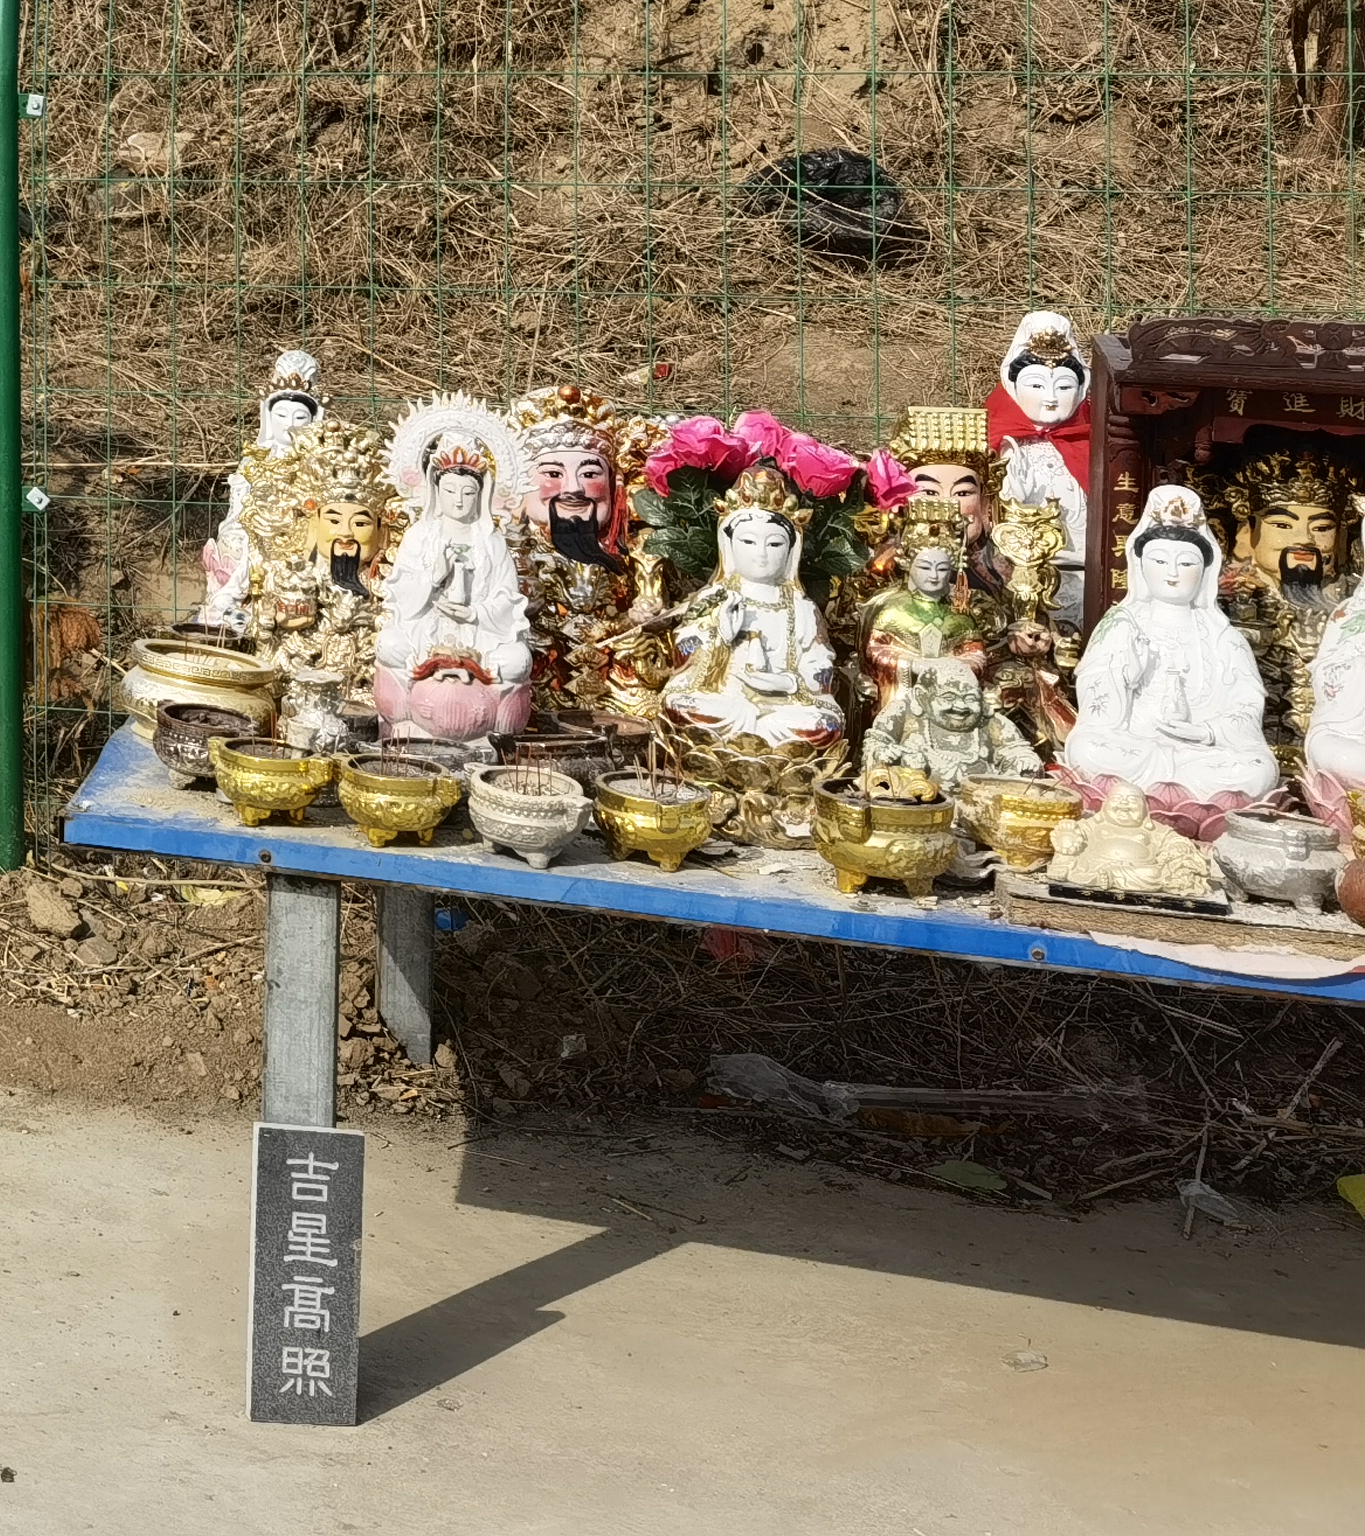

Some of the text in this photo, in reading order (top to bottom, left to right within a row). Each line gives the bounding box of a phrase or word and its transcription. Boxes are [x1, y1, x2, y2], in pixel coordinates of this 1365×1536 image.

[1110, 471, 1140, 607] 生意興隆
[278, 1151, 339, 1397] 吉星高照
